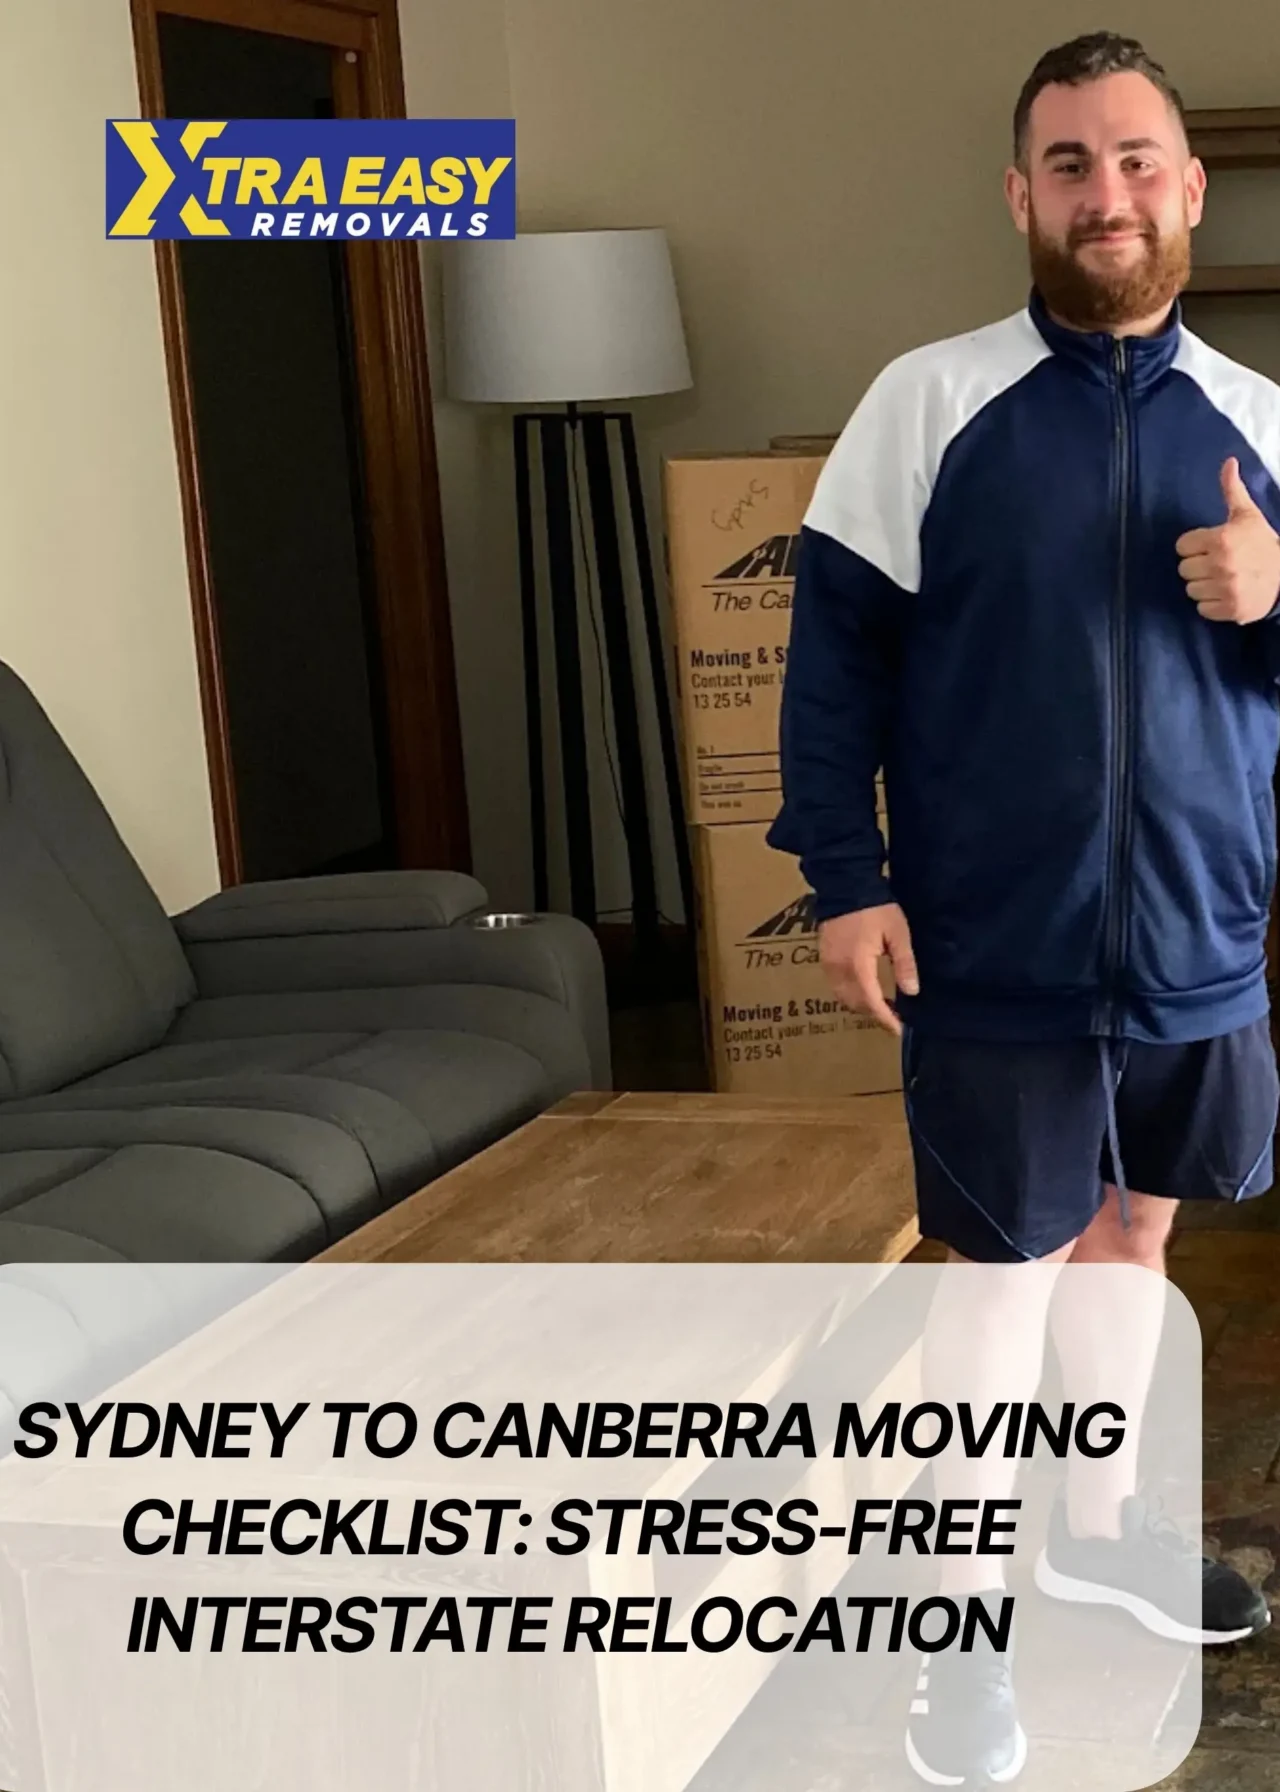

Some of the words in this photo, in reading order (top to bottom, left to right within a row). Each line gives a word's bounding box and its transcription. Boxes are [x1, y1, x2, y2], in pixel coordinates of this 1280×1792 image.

[712, 591, 752, 611] The
[691, 649, 752, 669] Moving
[757, 646, 768, 664] &
[691, 673, 742, 688] Contact
[746, 672, 775, 688] your
[693, 694, 709, 709] 13
[713, 693, 731, 708] 25
[734, 692, 752, 707] 54
[745, 949, 783, 969] The
[724, 1004, 783, 1022] Moving
[788, 1000, 799, 1017] &
[724, 1027, 773, 1042] Contact
[726, 1047, 740, 1062] 13
[744, 1045, 761, 1061] 25
[765, 1043, 781, 1059] 54
